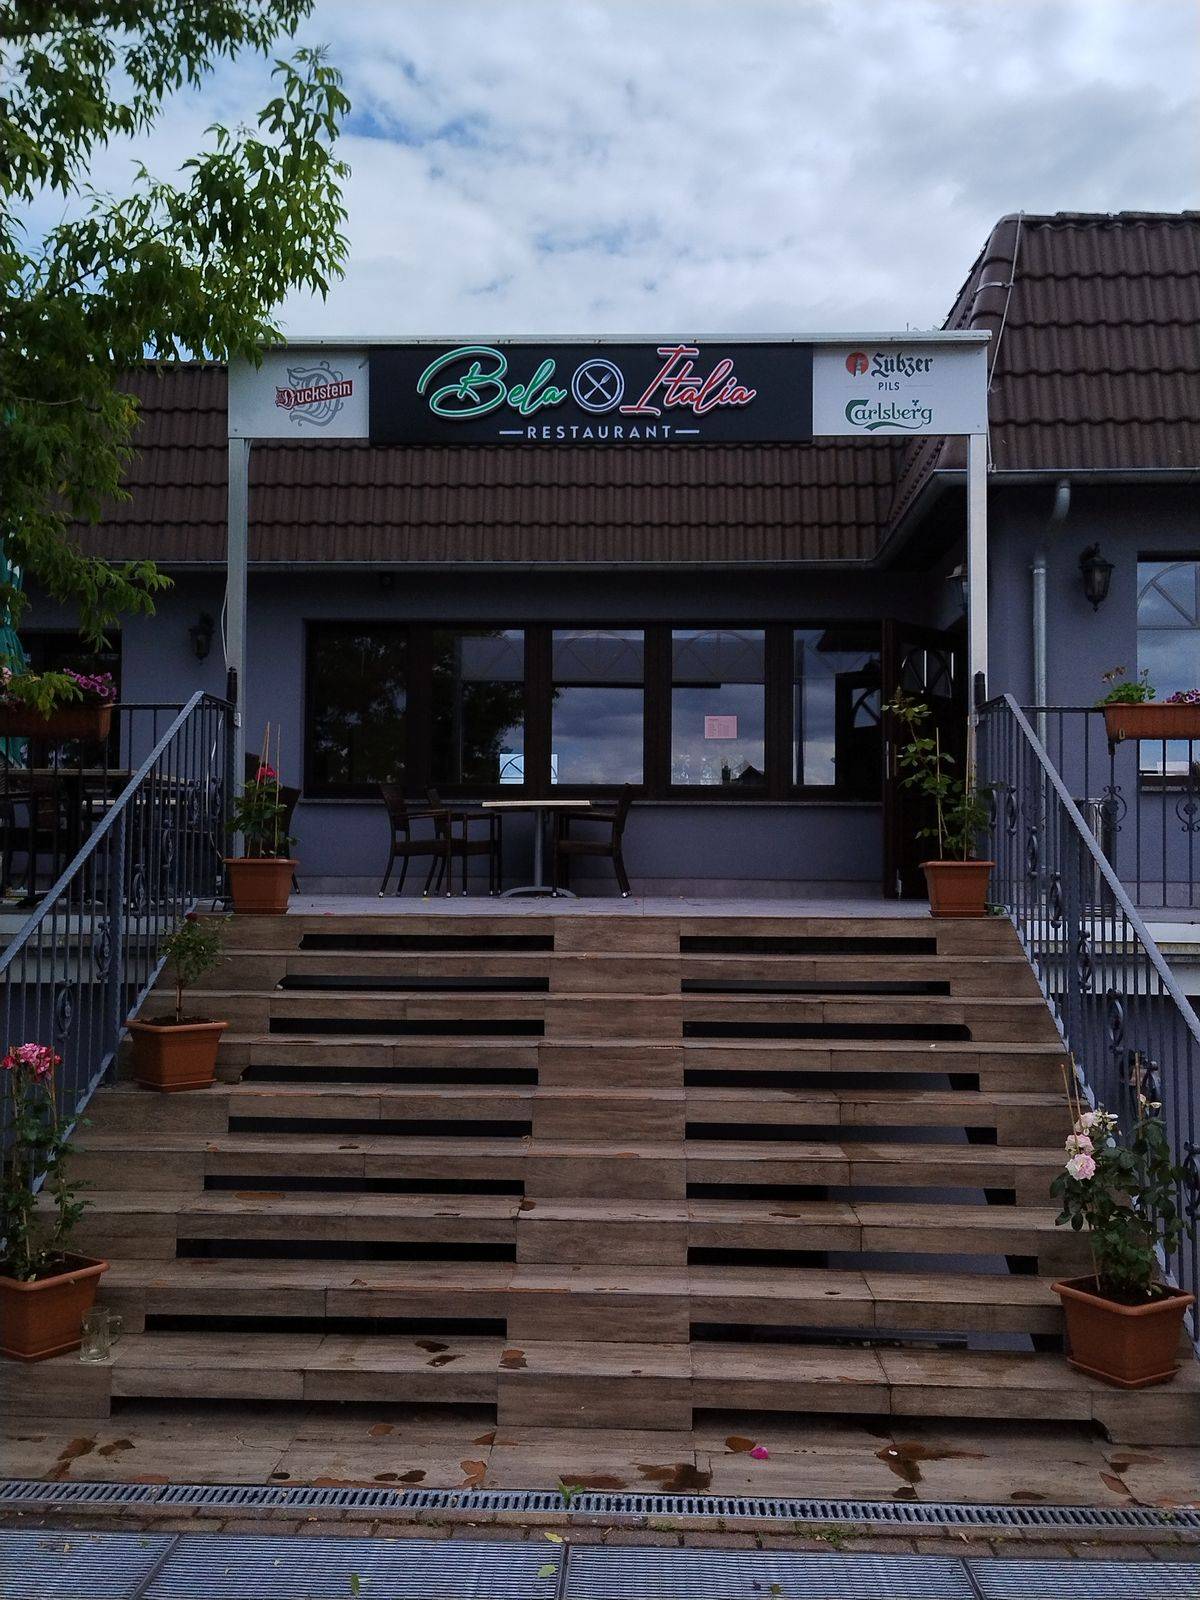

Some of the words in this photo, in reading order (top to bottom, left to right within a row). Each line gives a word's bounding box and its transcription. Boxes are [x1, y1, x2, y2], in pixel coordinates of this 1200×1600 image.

[871, 352, 933, 378] Lübzer
[416, 345, 568, 419] Bela
[619, 344, 757, 417] Italia
[878, 382, 900, 391] PILS
[275, 382, 352, 410] Duckstein
[845, 399, 933, 430] Carlsberg
[527, 425, 671, 439] RESTAURANT
